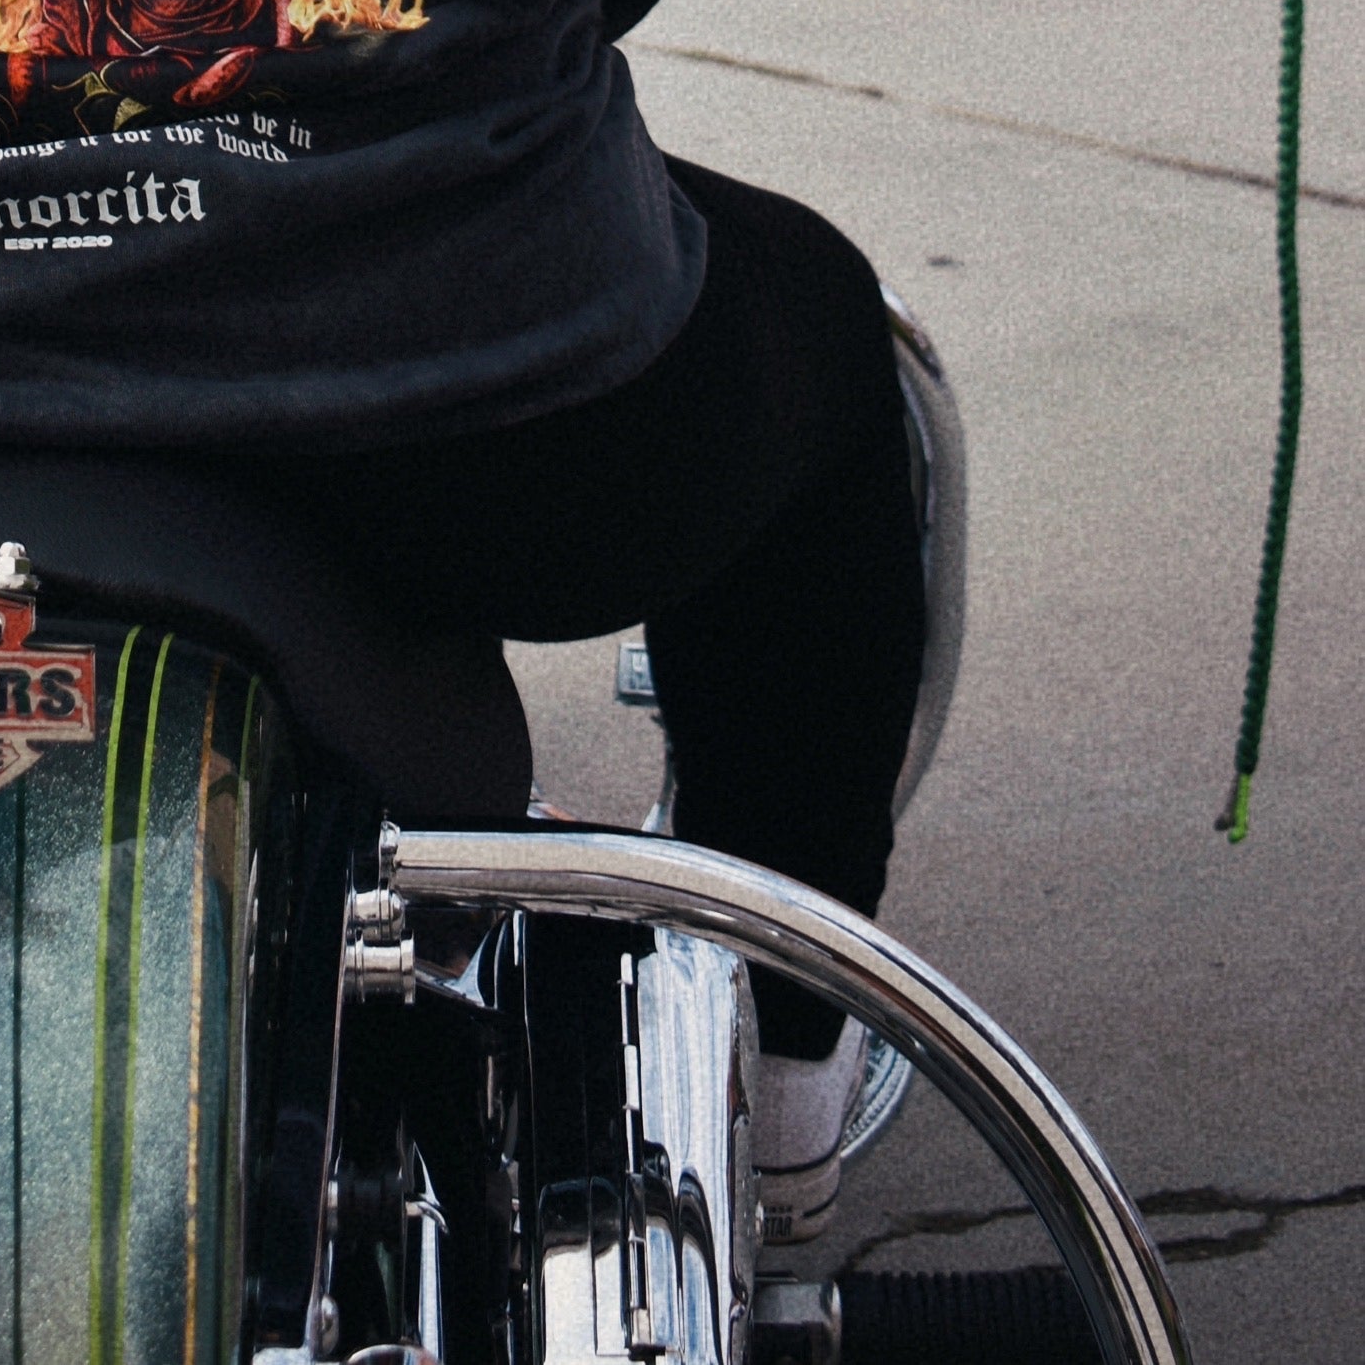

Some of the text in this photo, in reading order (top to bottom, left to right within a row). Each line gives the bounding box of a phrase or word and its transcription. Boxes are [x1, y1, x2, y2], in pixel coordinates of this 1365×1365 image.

[215, 126, 289, 162] world
[252, 111, 278, 137] be
[289, 118, 312, 149] in
[3, 234, 114, 251] EST 2020
